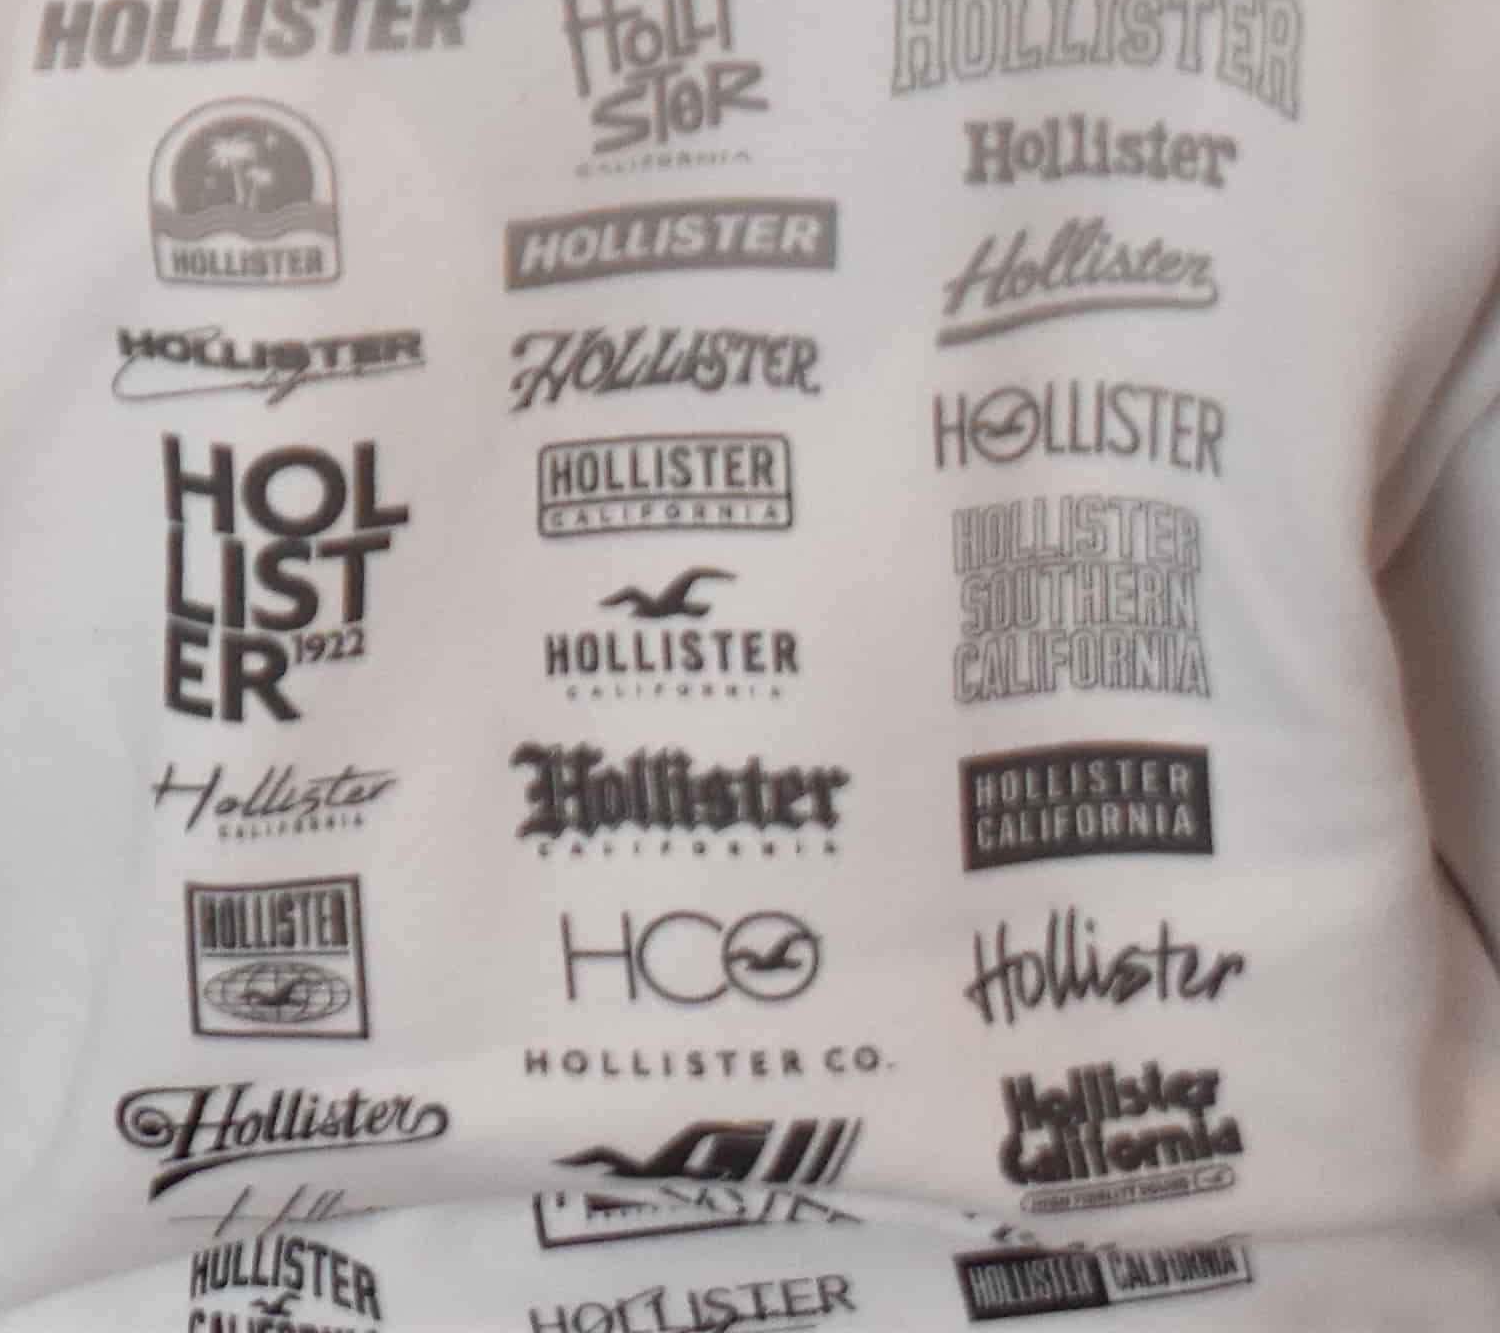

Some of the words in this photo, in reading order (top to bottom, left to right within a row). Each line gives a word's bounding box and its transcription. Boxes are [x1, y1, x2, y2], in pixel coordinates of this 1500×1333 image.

[963, 112, 1237, 188] Hollister
[172, 245, 324, 277] HOLLISTER
[518, 211, 822, 276] HOLLISTER
[941, 217, 1218, 317] Hollister
[116, 327, 424, 373] HOLLISTER
[932, 378, 1226, 479] HOLLISTER
[161, 432, 411, 537] HOL
[549, 443, 775, 497] HOLLISTER
[550, 501, 778, 528] CALIFORNIA
[951, 494, 1202, 575] HOLLISTER
[165, 521, 392, 632] LIST
[958, 561, 1200, 637] SOUTHERN
[164, 629, 304, 724] ER
[291, 628, 366, 665] 1922
[544, 629, 800, 677] HOLLISTER
[951, 628, 1212, 706] CALIFORNIA
[566, 683, 782, 701] CALIFORNIA
[151, 762, 400, 833] Hollister
[508, 740, 851, 839] Hollister
[976, 760, 1191, 809] HOLLISTER
[537, 839, 840, 857] CALIFORNIA
[976, 802, 1194, 851] CALIFORNIA
[201, 887, 350, 951] HOLLISTER
[964, 904, 1247, 1026] Hollister
[524, 1047, 806, 1078] HOLLISTER
[824, 1043, 897, 1075] CO.
[1000, 1060, 1220, 1132] Hollister
[115, 1081, 450, 1173] Hollister
[1000, 1109, 1244, 1185] California
